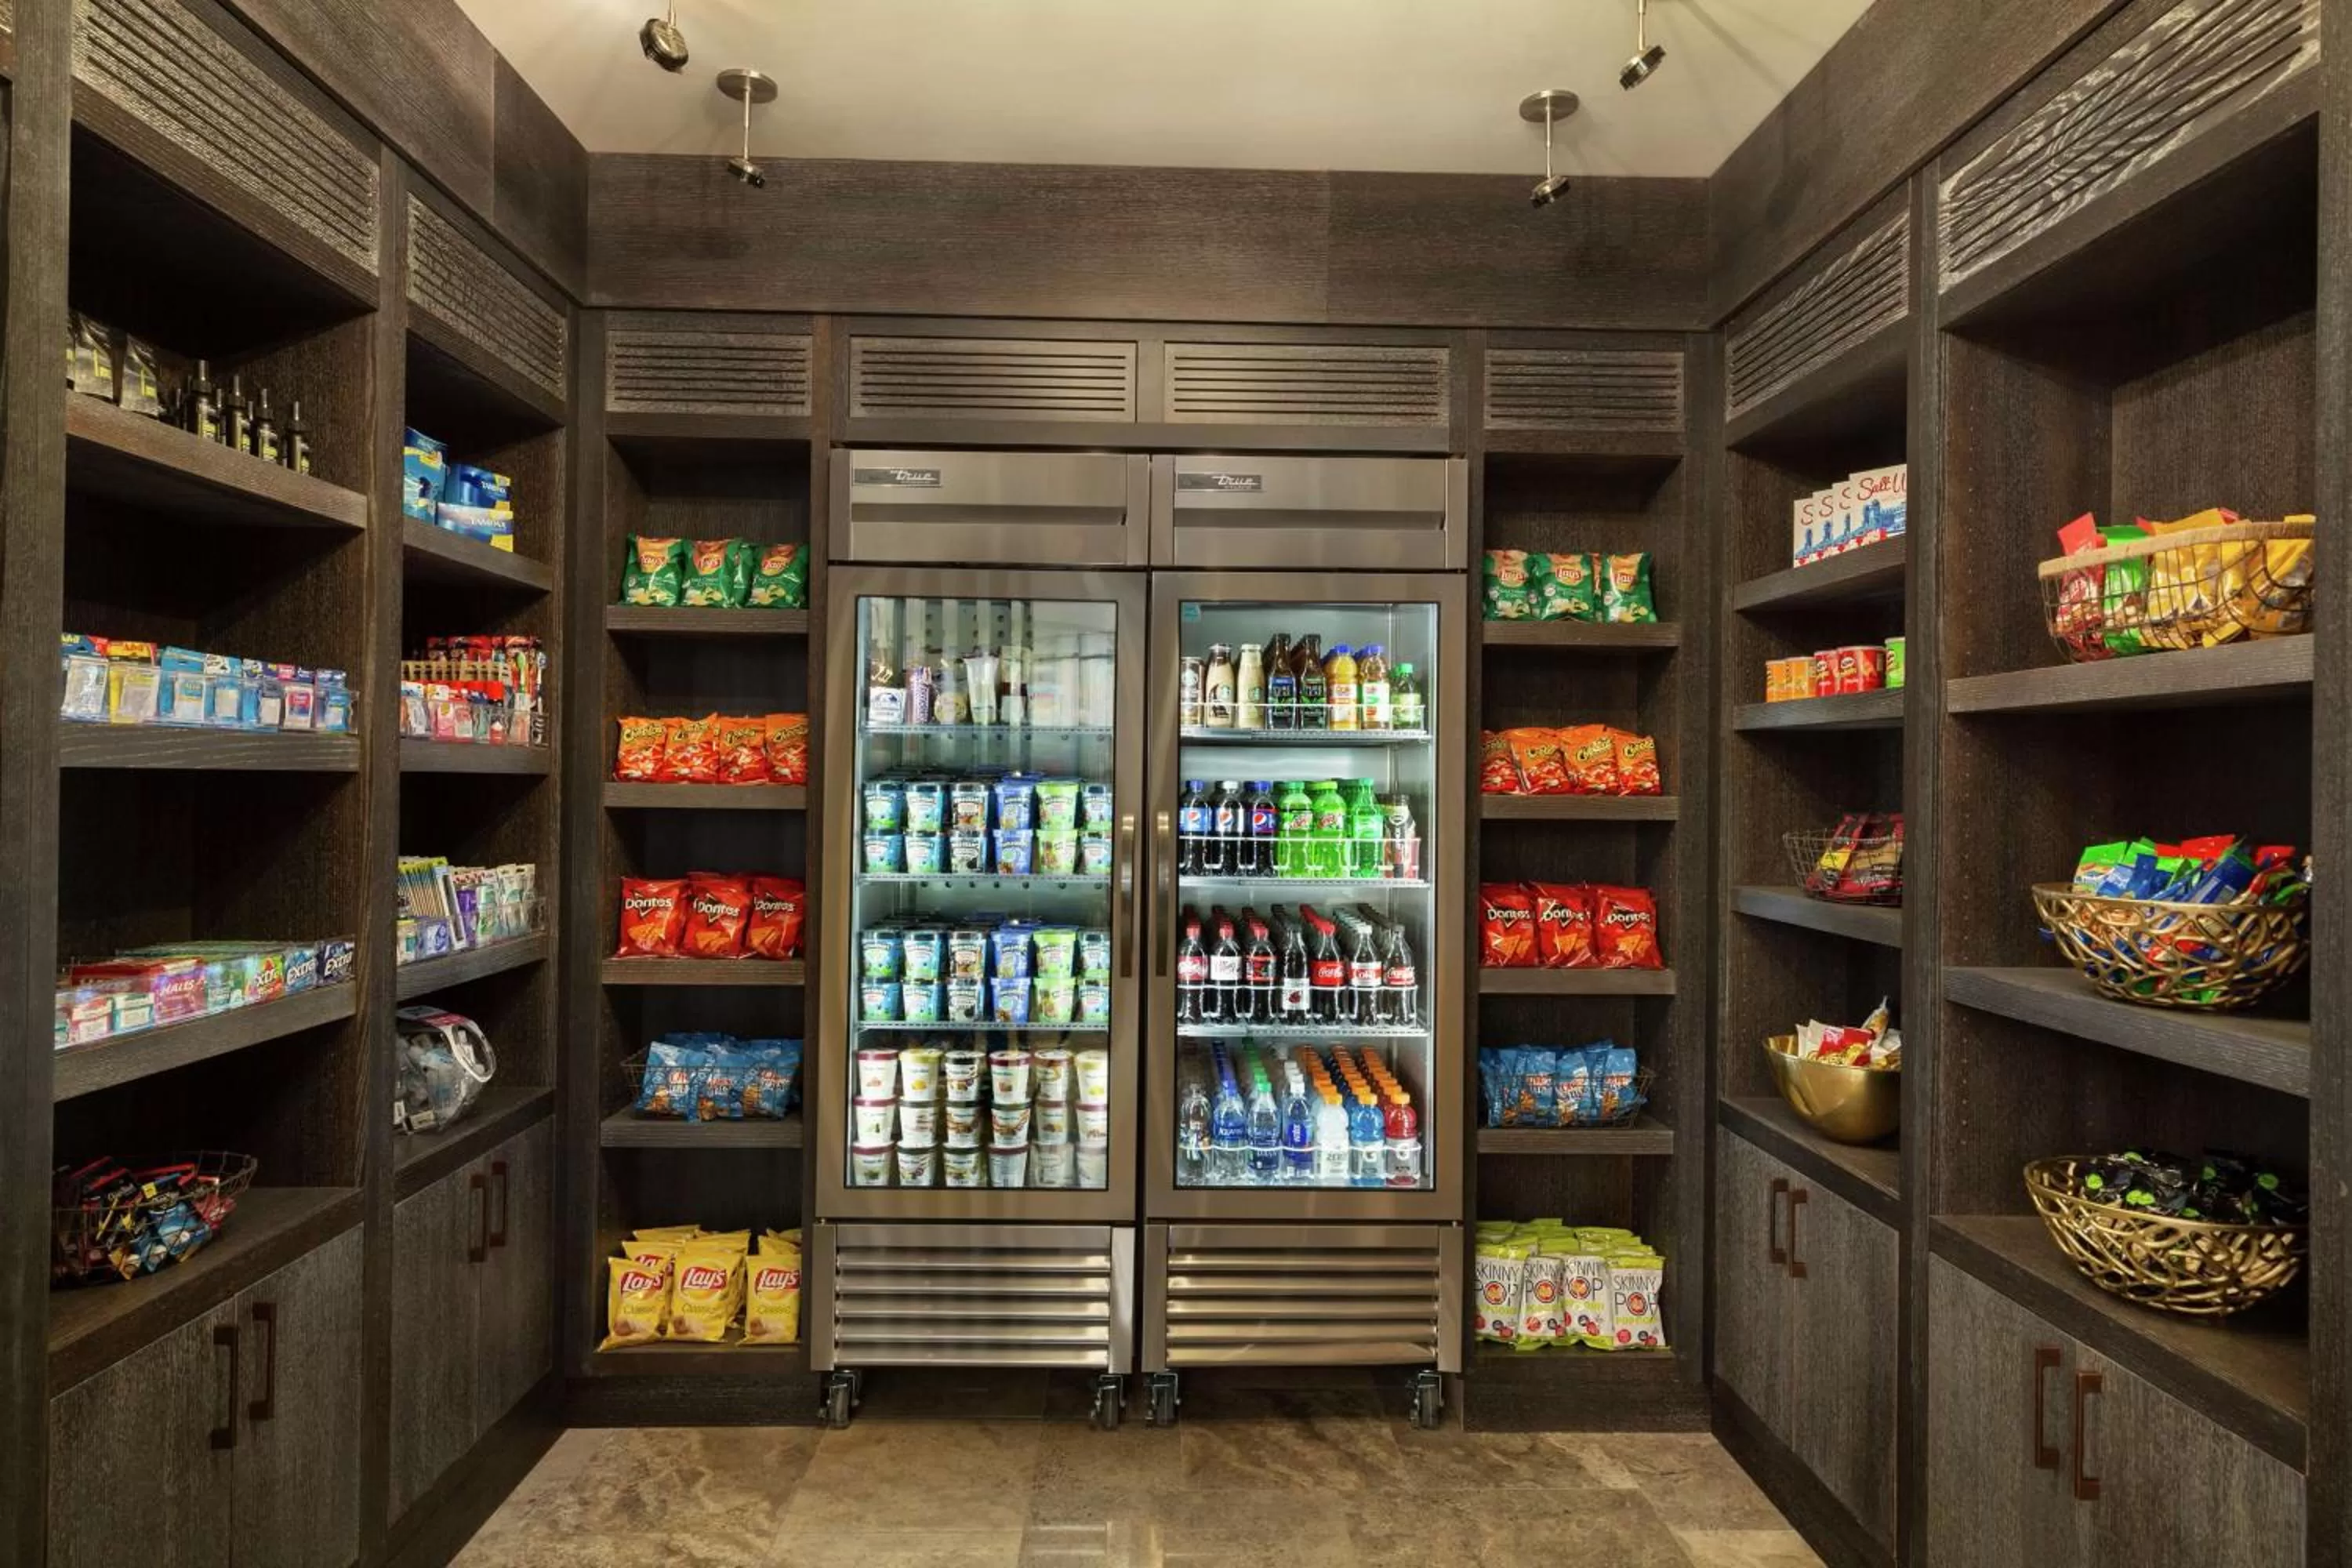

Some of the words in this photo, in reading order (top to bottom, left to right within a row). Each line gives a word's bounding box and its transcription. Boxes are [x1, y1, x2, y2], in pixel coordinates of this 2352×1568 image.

[625, 897, 673, 910] Doritos
[684, 1267, 728, 1290] Lay's
[757, 1267, 800, 1290] Lay's
